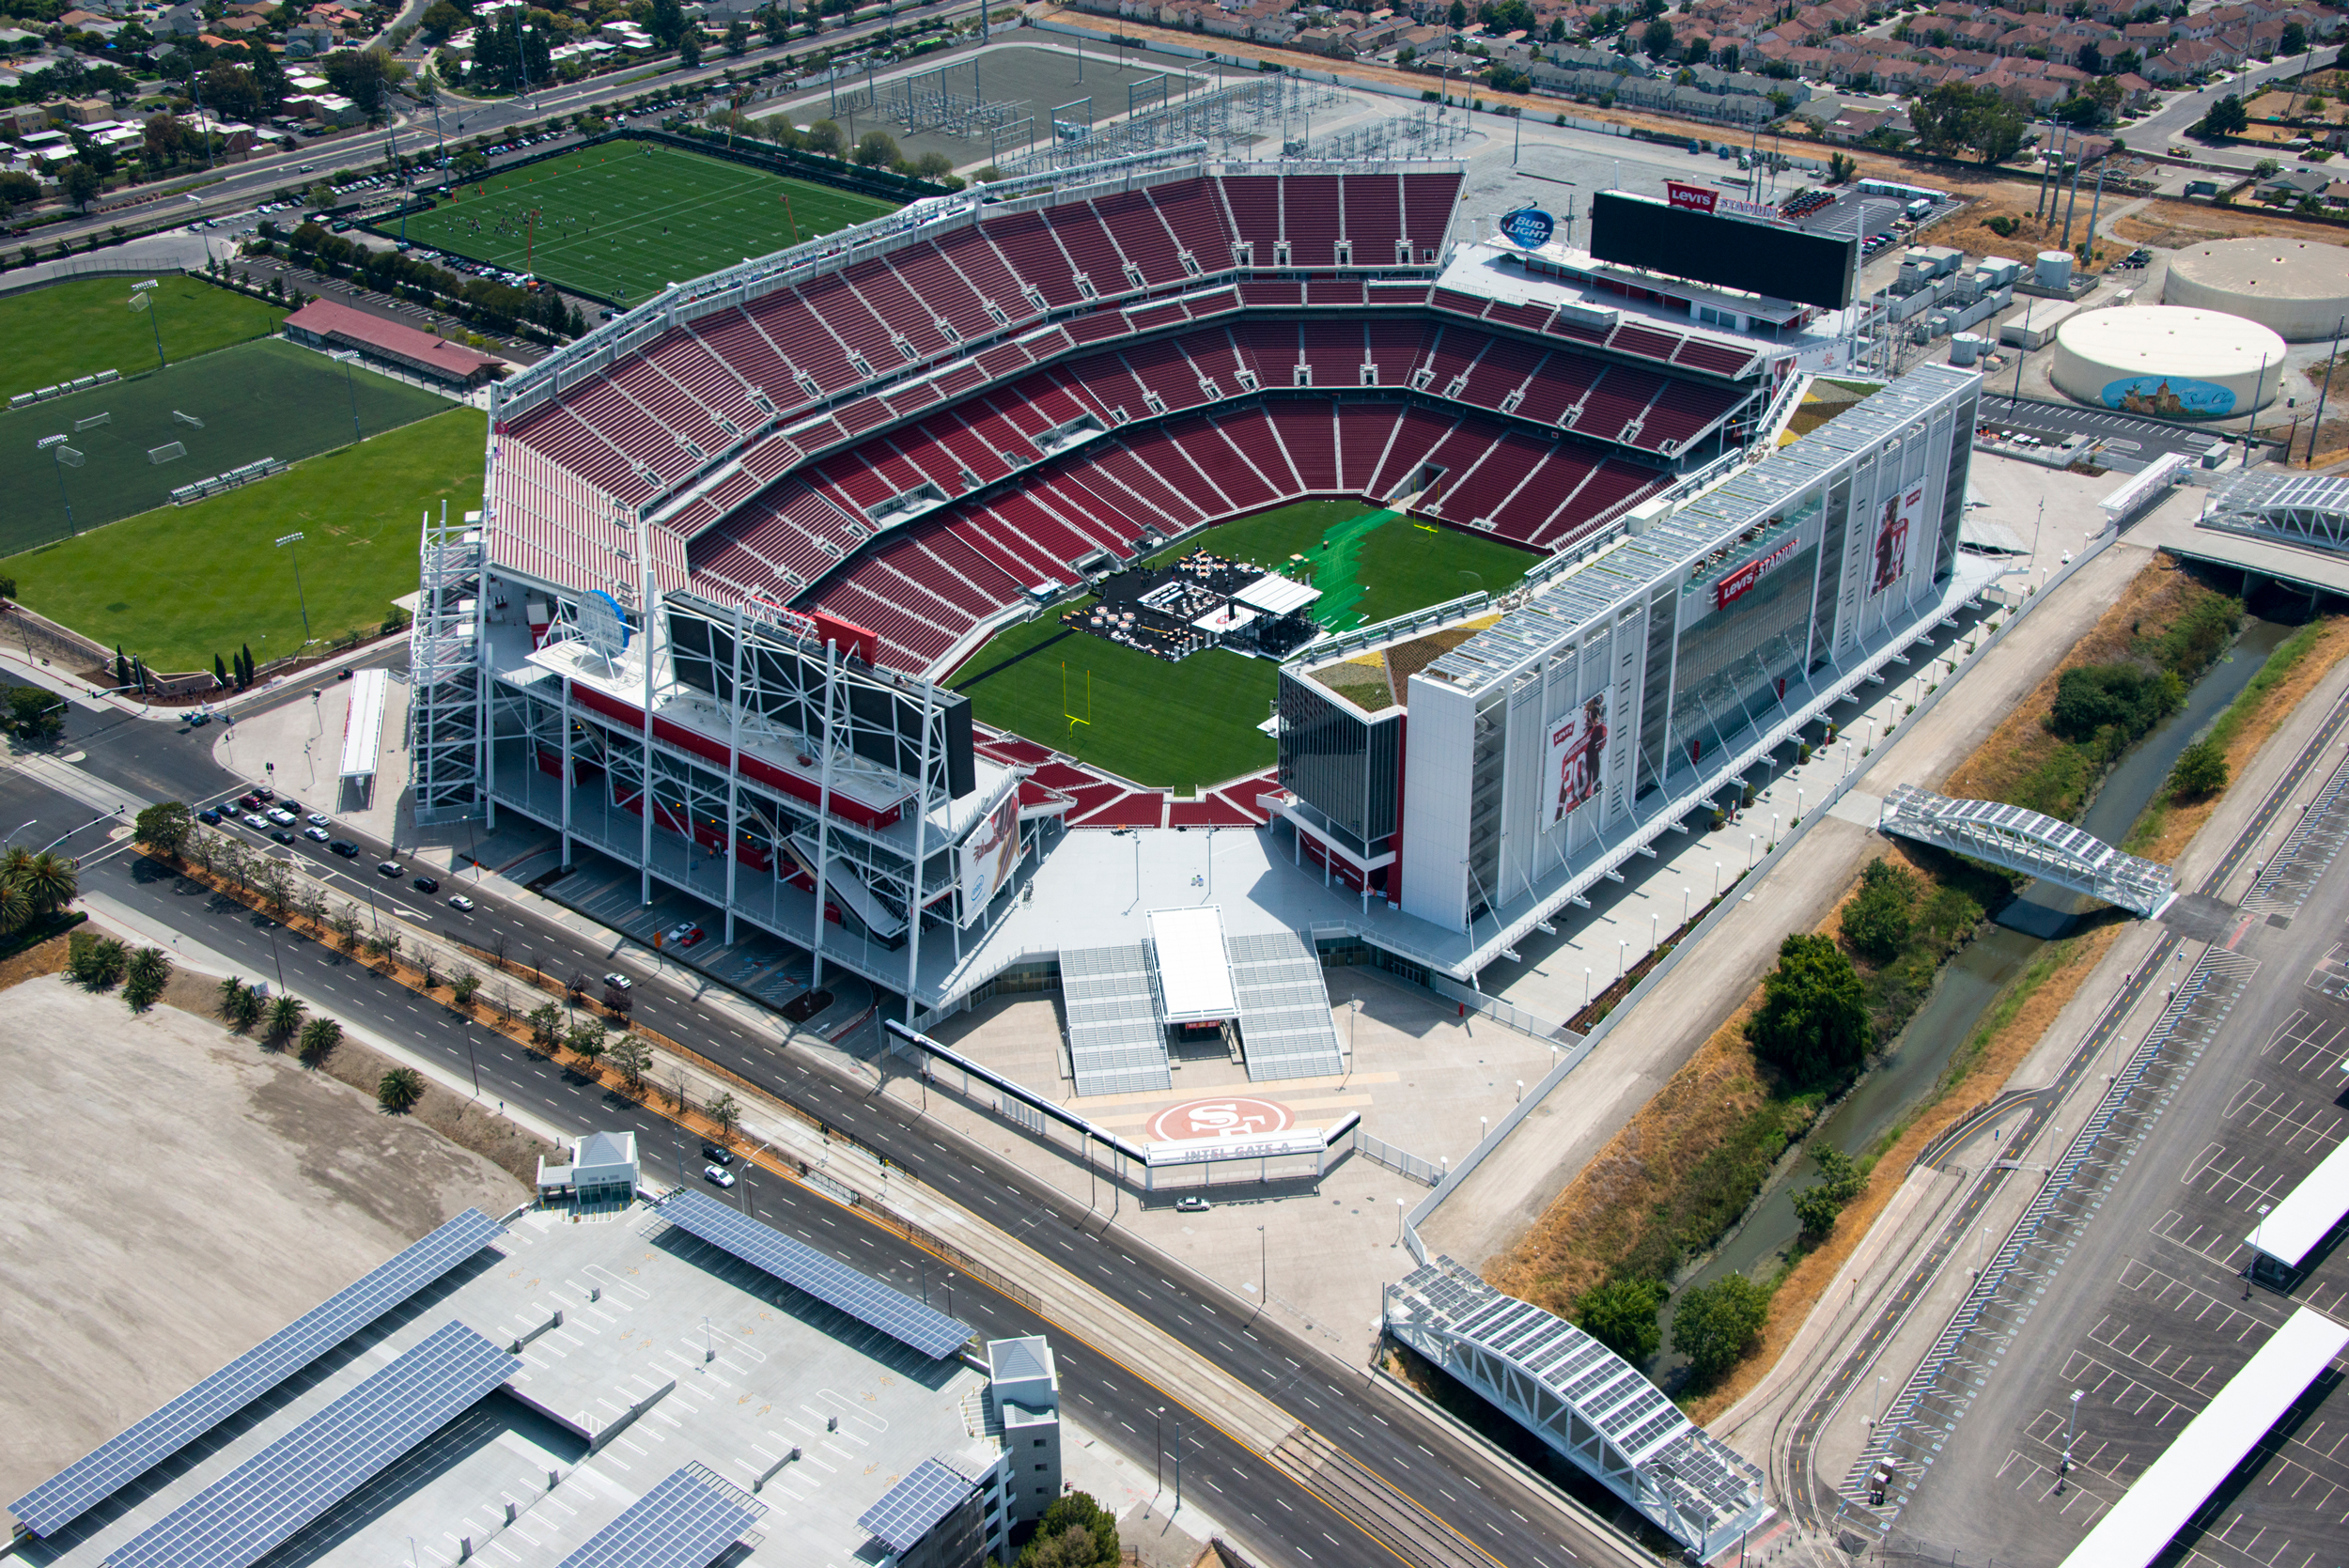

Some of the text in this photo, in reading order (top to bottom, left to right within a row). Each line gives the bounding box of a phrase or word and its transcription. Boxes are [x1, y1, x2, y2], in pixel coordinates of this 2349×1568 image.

[1719, 197, 1778, 219] STADIUM
[1507, 224, 1549, 240] LIGHT
[1515, 216, 1546, 230] BUD
[1524, 237, 1541, 245] PATIO
[1758, 538, 1799, 577] STADIUM
[1185, 1141, 1291, 1162] INTEL GATE A
